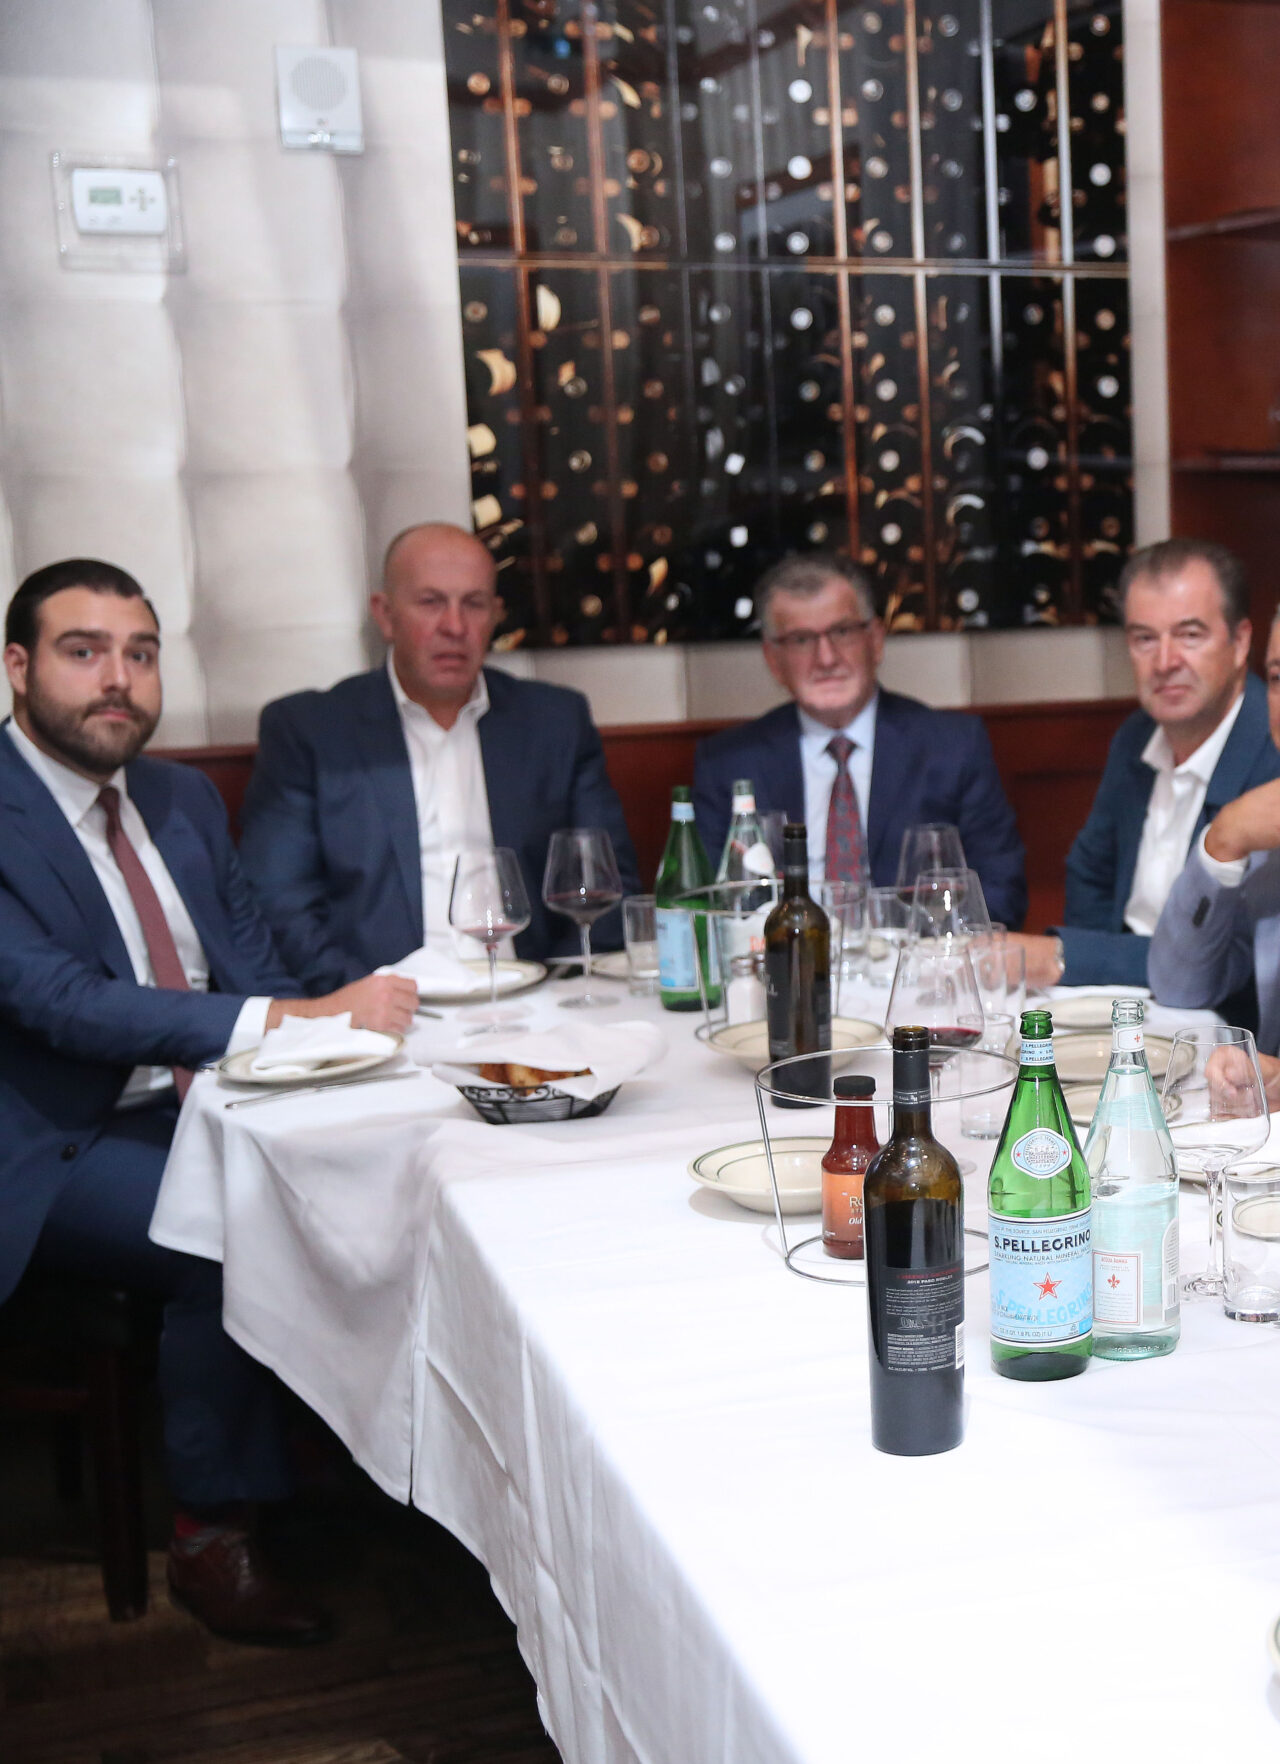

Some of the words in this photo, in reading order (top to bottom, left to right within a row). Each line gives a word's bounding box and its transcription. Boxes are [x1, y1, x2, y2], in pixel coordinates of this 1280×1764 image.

[994, 1228, 1091, 1253] S.PELLEGRINO
[994, 1250, 1021, 1261] SPARKLING
[1055, 1251, 1080, 1260] MINERAL
